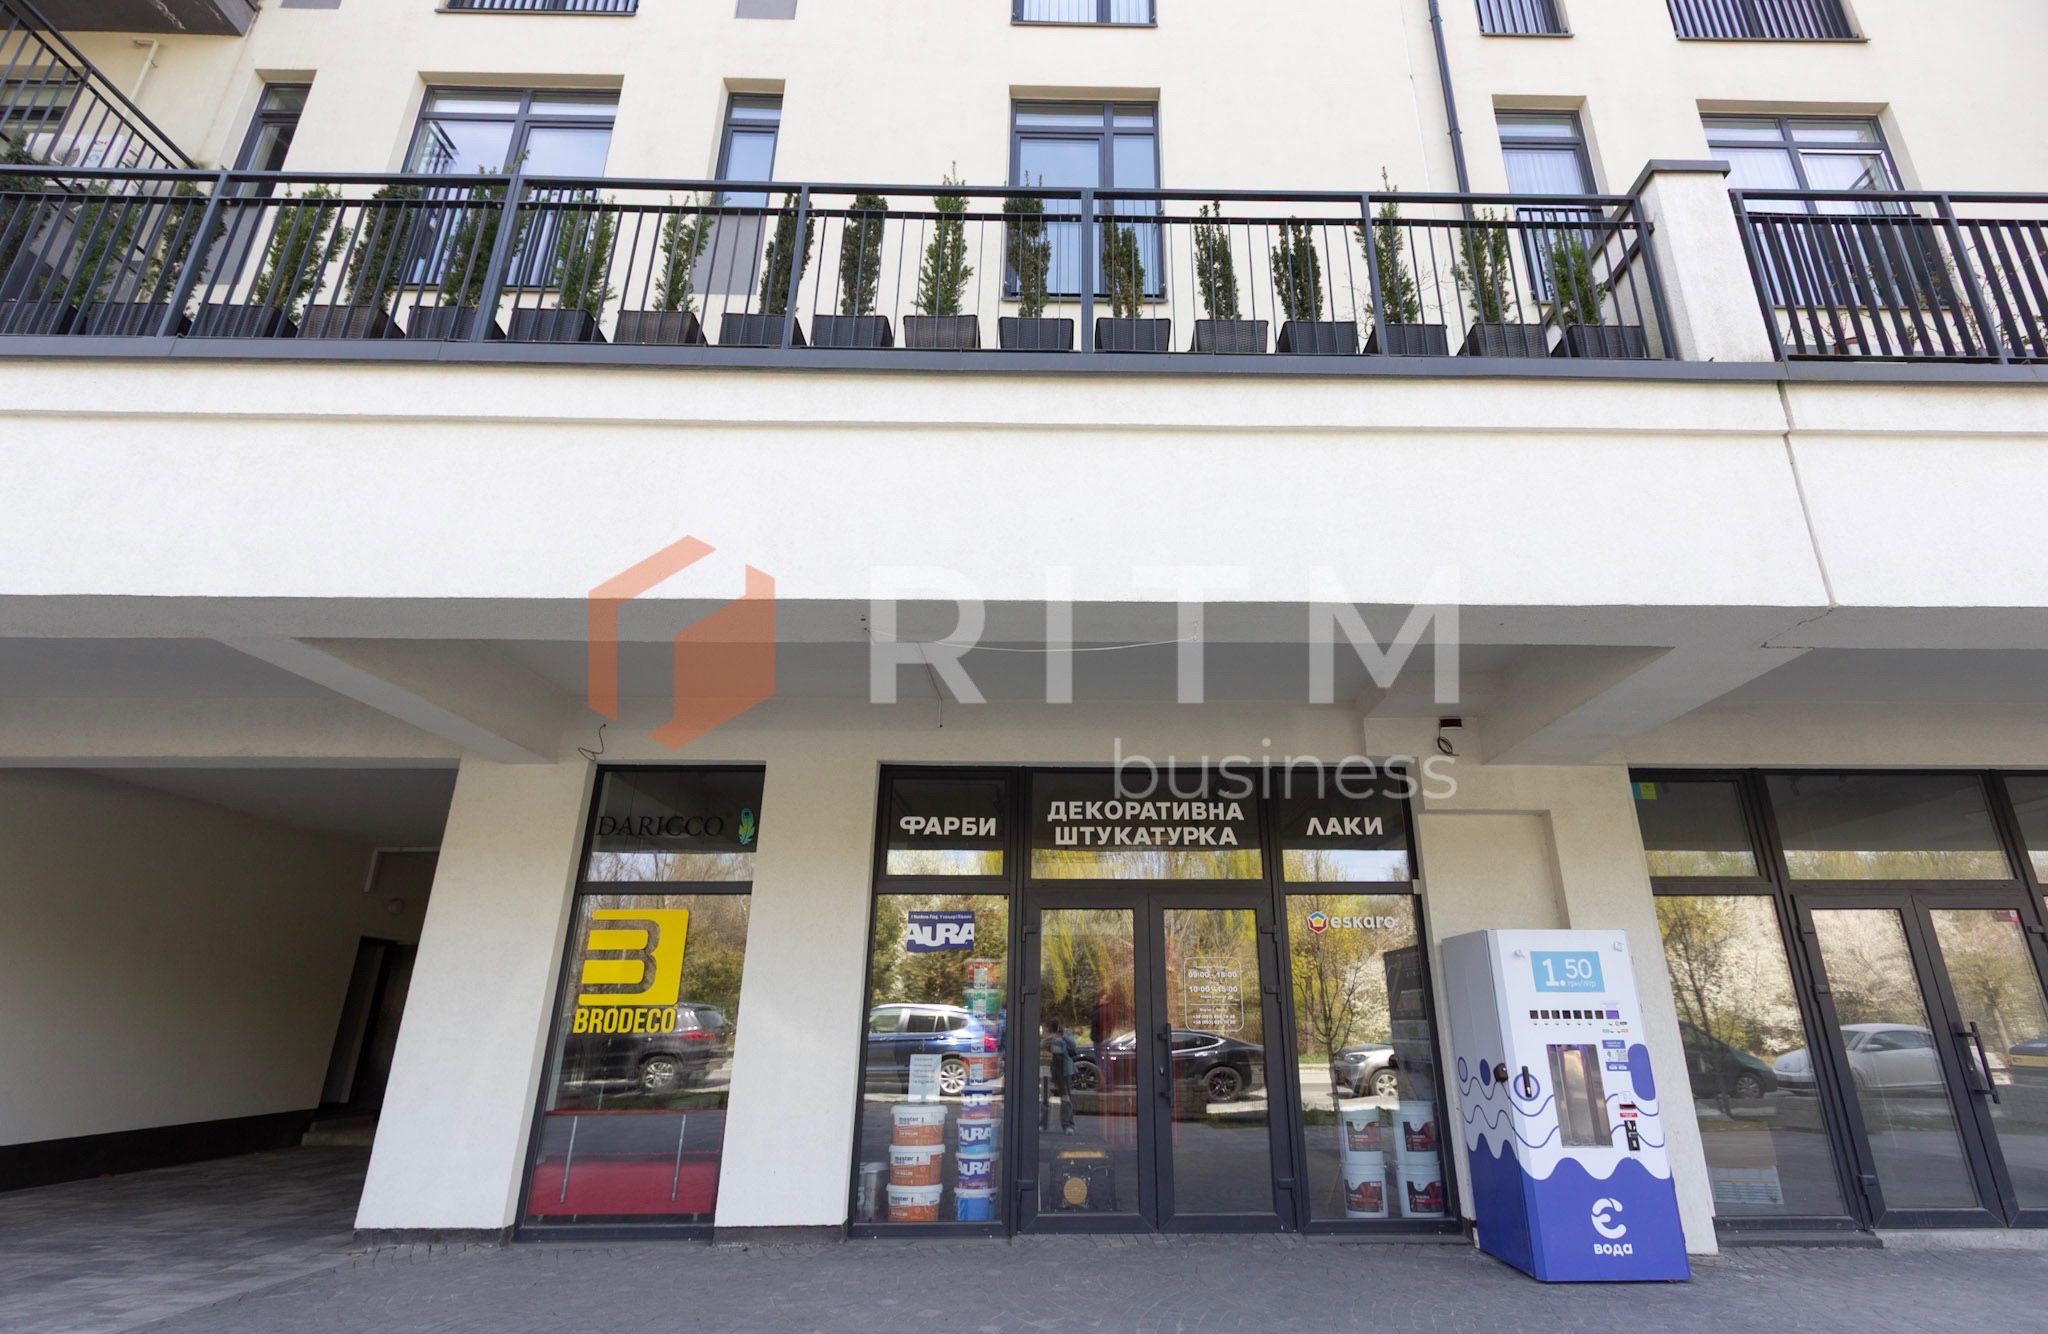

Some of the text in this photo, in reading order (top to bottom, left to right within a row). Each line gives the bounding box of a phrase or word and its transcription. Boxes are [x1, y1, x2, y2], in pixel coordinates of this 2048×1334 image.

[1047, 800, 1245, 822] ДЕКОРАТИВНА
[596, 815, 725, 837] DARICCO
[899, 816, 997, 837] ФАРБИ
[1055, 826, 1239, 846] ШТУКАТУРКА
[1306, 816, 1384, 836] ЛАКИ
[1330, 916, 1395, 929] eskaro
[907, 923, 975, 947] AURA
[572, 1008, 677, 1034] BRODECO
[959, 1127, 992, 1141] AURA
[958, 1161, 991, 1176] AURA
[1593, 1243, 1633, 1257] вода
